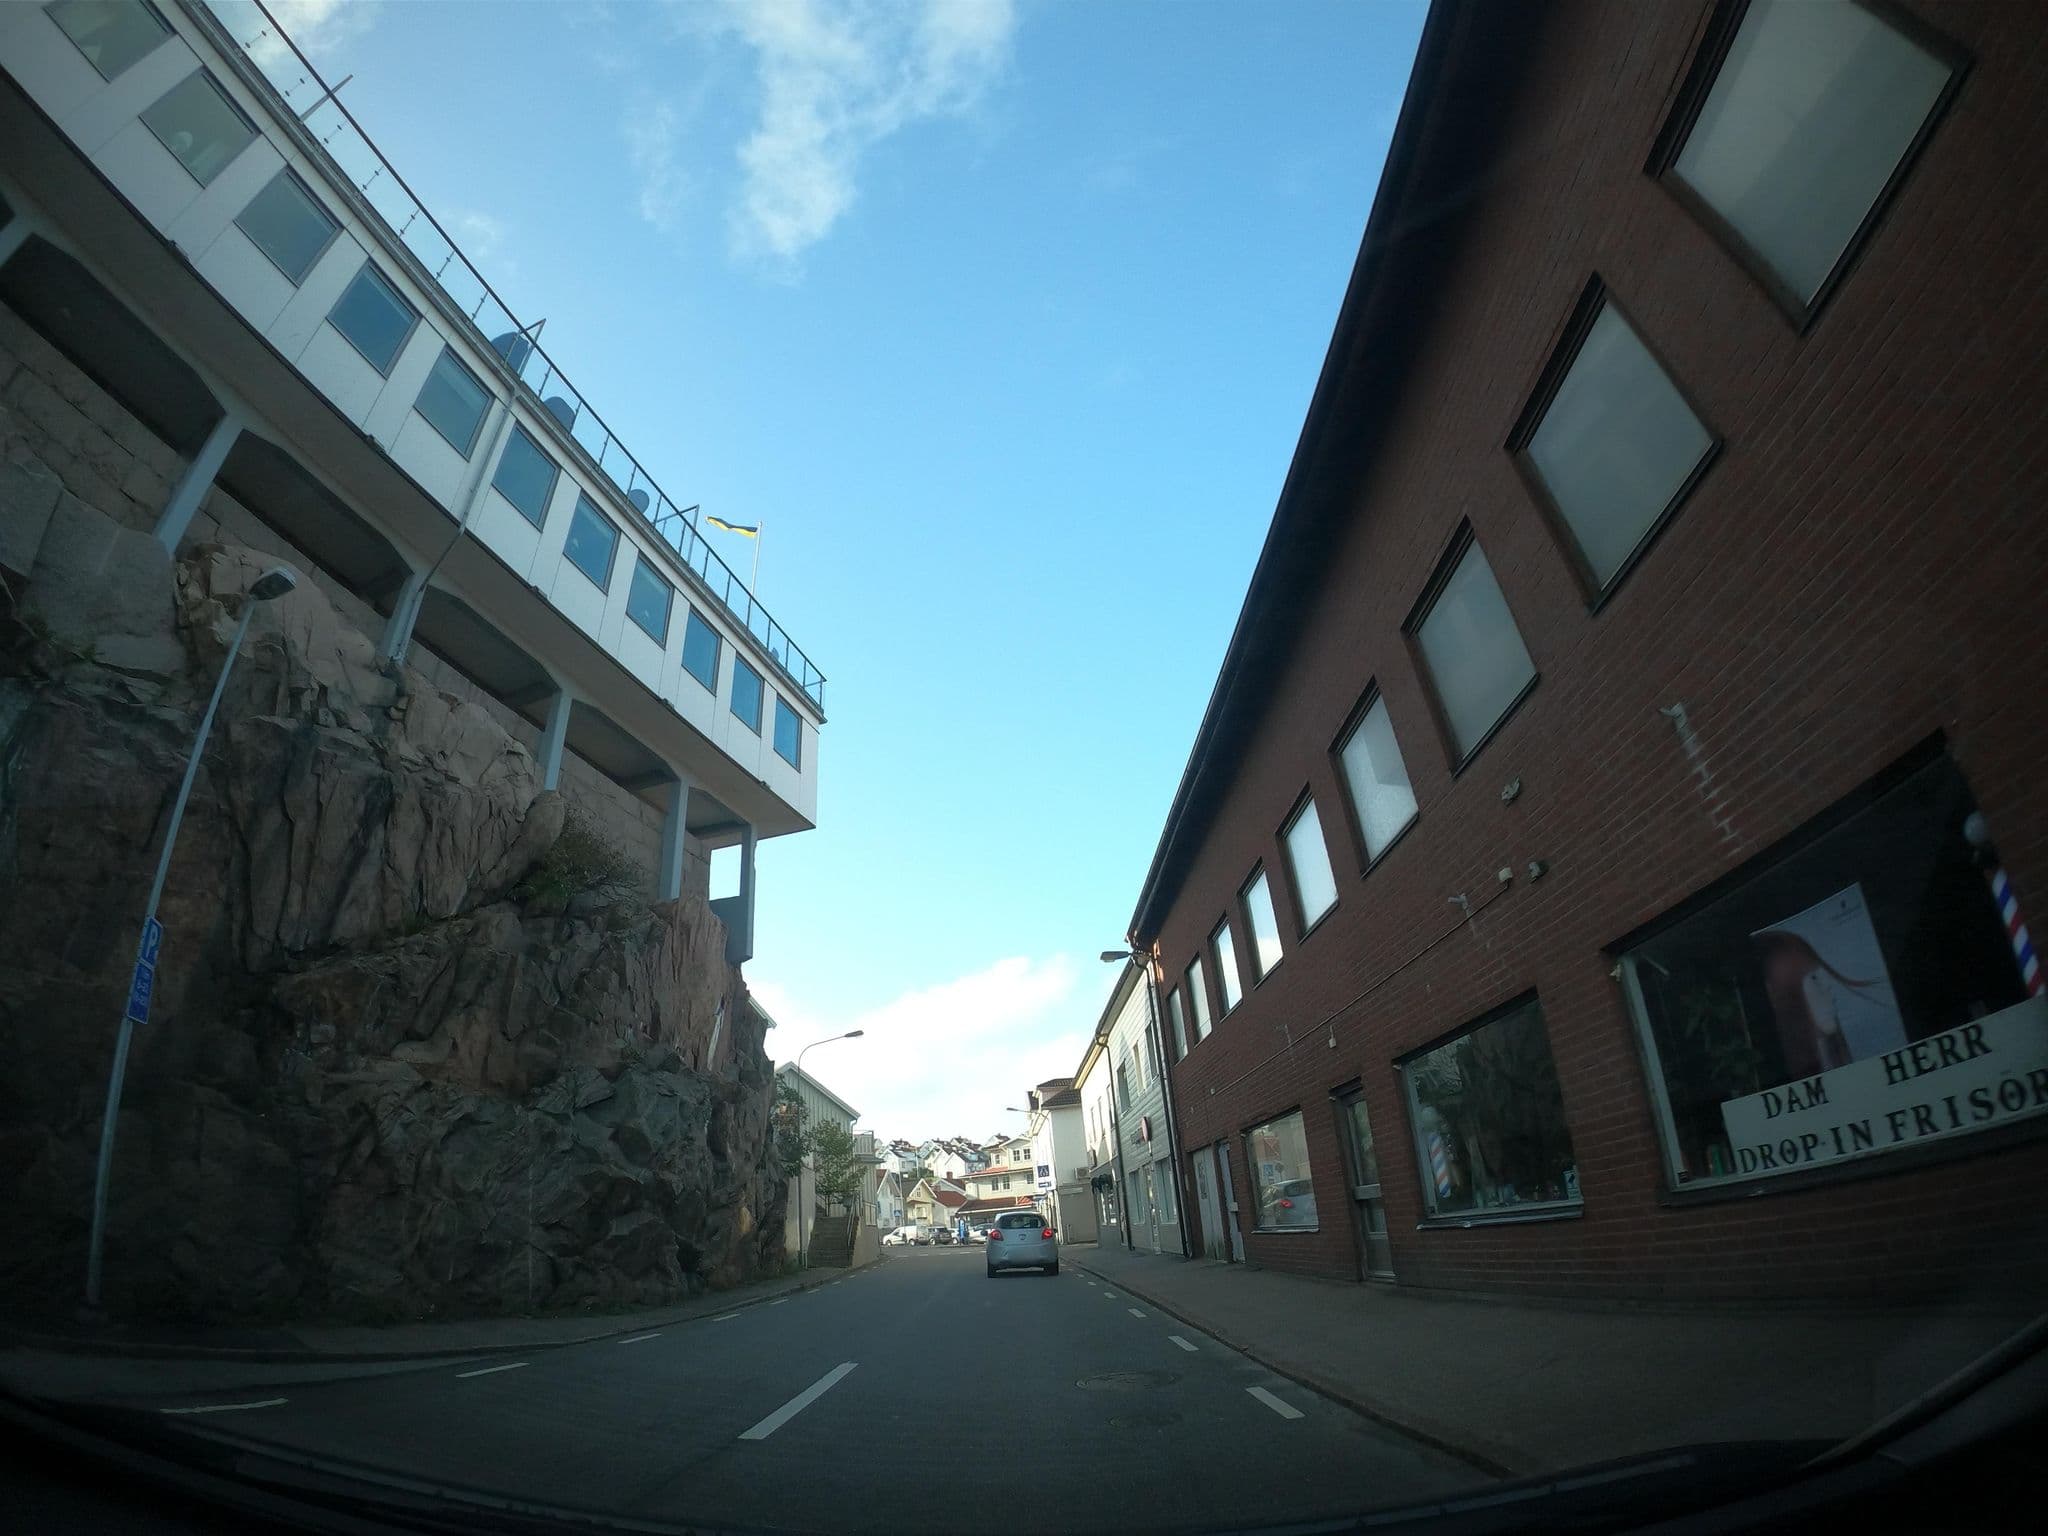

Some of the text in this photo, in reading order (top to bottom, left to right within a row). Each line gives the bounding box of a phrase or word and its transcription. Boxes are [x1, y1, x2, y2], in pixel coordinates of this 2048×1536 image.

[146, 924, 158, 958] P
[1761, 1023, 1993, 1119] DAM HERR
